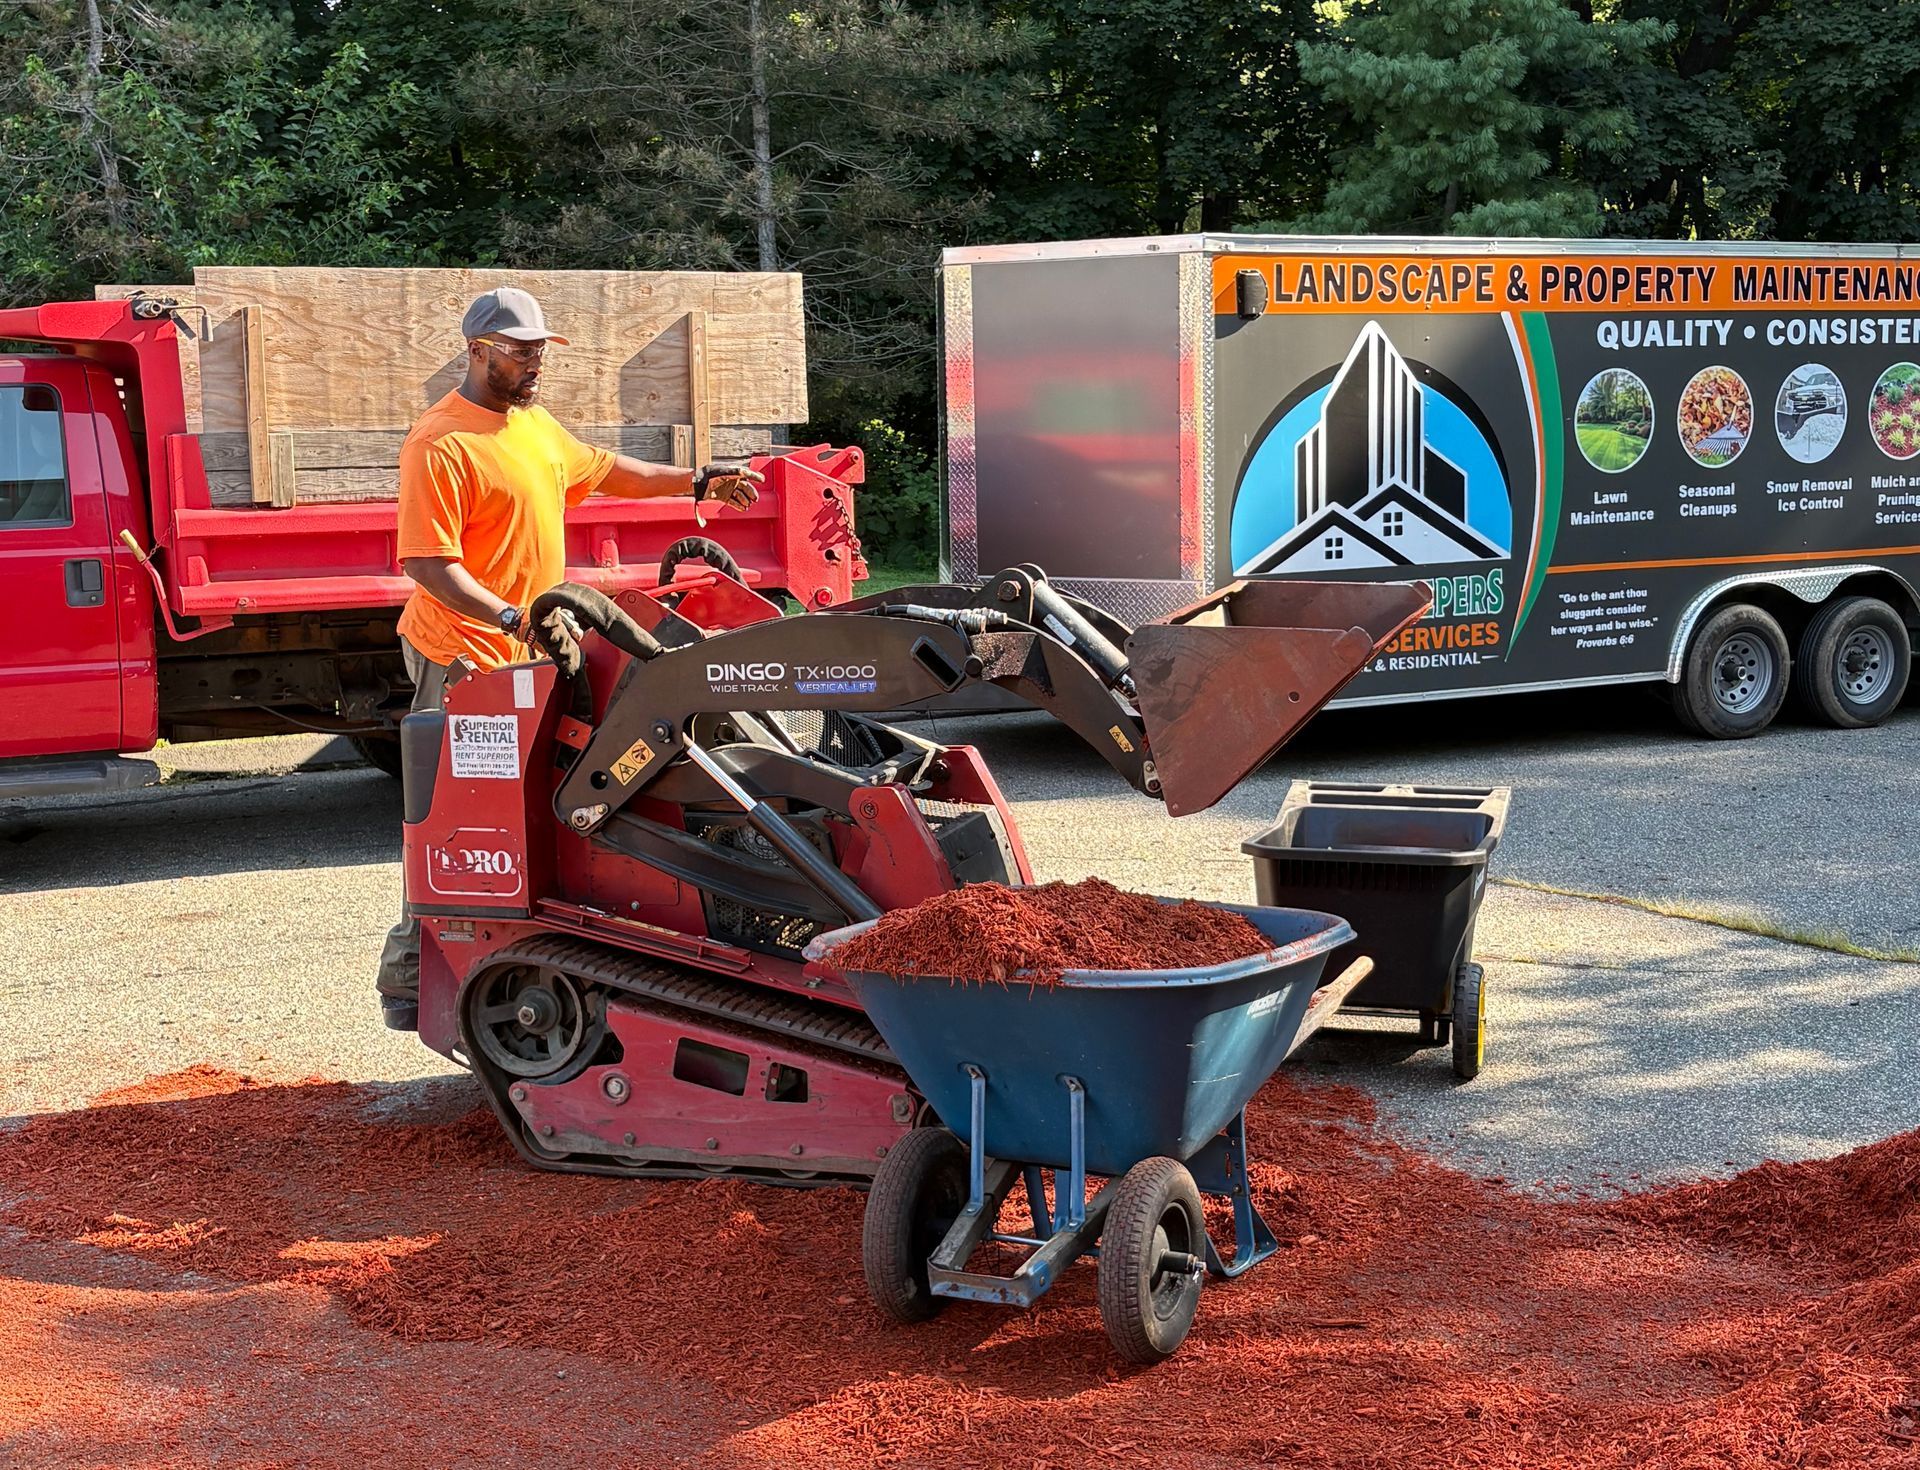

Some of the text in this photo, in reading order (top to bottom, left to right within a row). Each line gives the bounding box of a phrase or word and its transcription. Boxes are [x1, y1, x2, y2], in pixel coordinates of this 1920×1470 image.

[1274, 263, 1920, 303] LANDSCAPE & PROPERTY MAINTENAN
[1596, 318, 1734, 350] QUALITY
[1766, 477, 1853, 494] Snow Removal
[1871, 474, 1906, 489] Mulch
[1593, 491, 1628, 505] Lawn
[1679, 482, 1736, 499] Seasonal
[1777, 495, 1844, 512] Ice Control
[1878, 492, 1920, 507] Pruning
[1570, 509, 1655, 526] Maintenance
[1679, 503, 1737, 518] Cleanups
[1418, 568, 1505, 619] PERS
[1579, 592, 1589, 602] to
[1591, 591, 1607, 601] the
[1609, 590, 1625, 600] ant
[1626, 588, 1648, 598] thou
[1560, 603, 1647, 620] sluggard: consider
[1551, 616, 1659, 636] her ways and be wise."
[1576, 634, 1635, 648] Proverbs 6:6
[1374, 659, 1387, 672] &
[1389, 652, 1481, 670] RESIDENTIAL
[706, 662, 786, 681] DINGO
[710, 682, 877, 693] WIDE TRACK VERTICAL LIFT
[460, 719, 514, 732] SUPERIOR
[461, 731, 516, 744] RENTAL
[455, 752, 515, 760] RENT SUPERIOR
